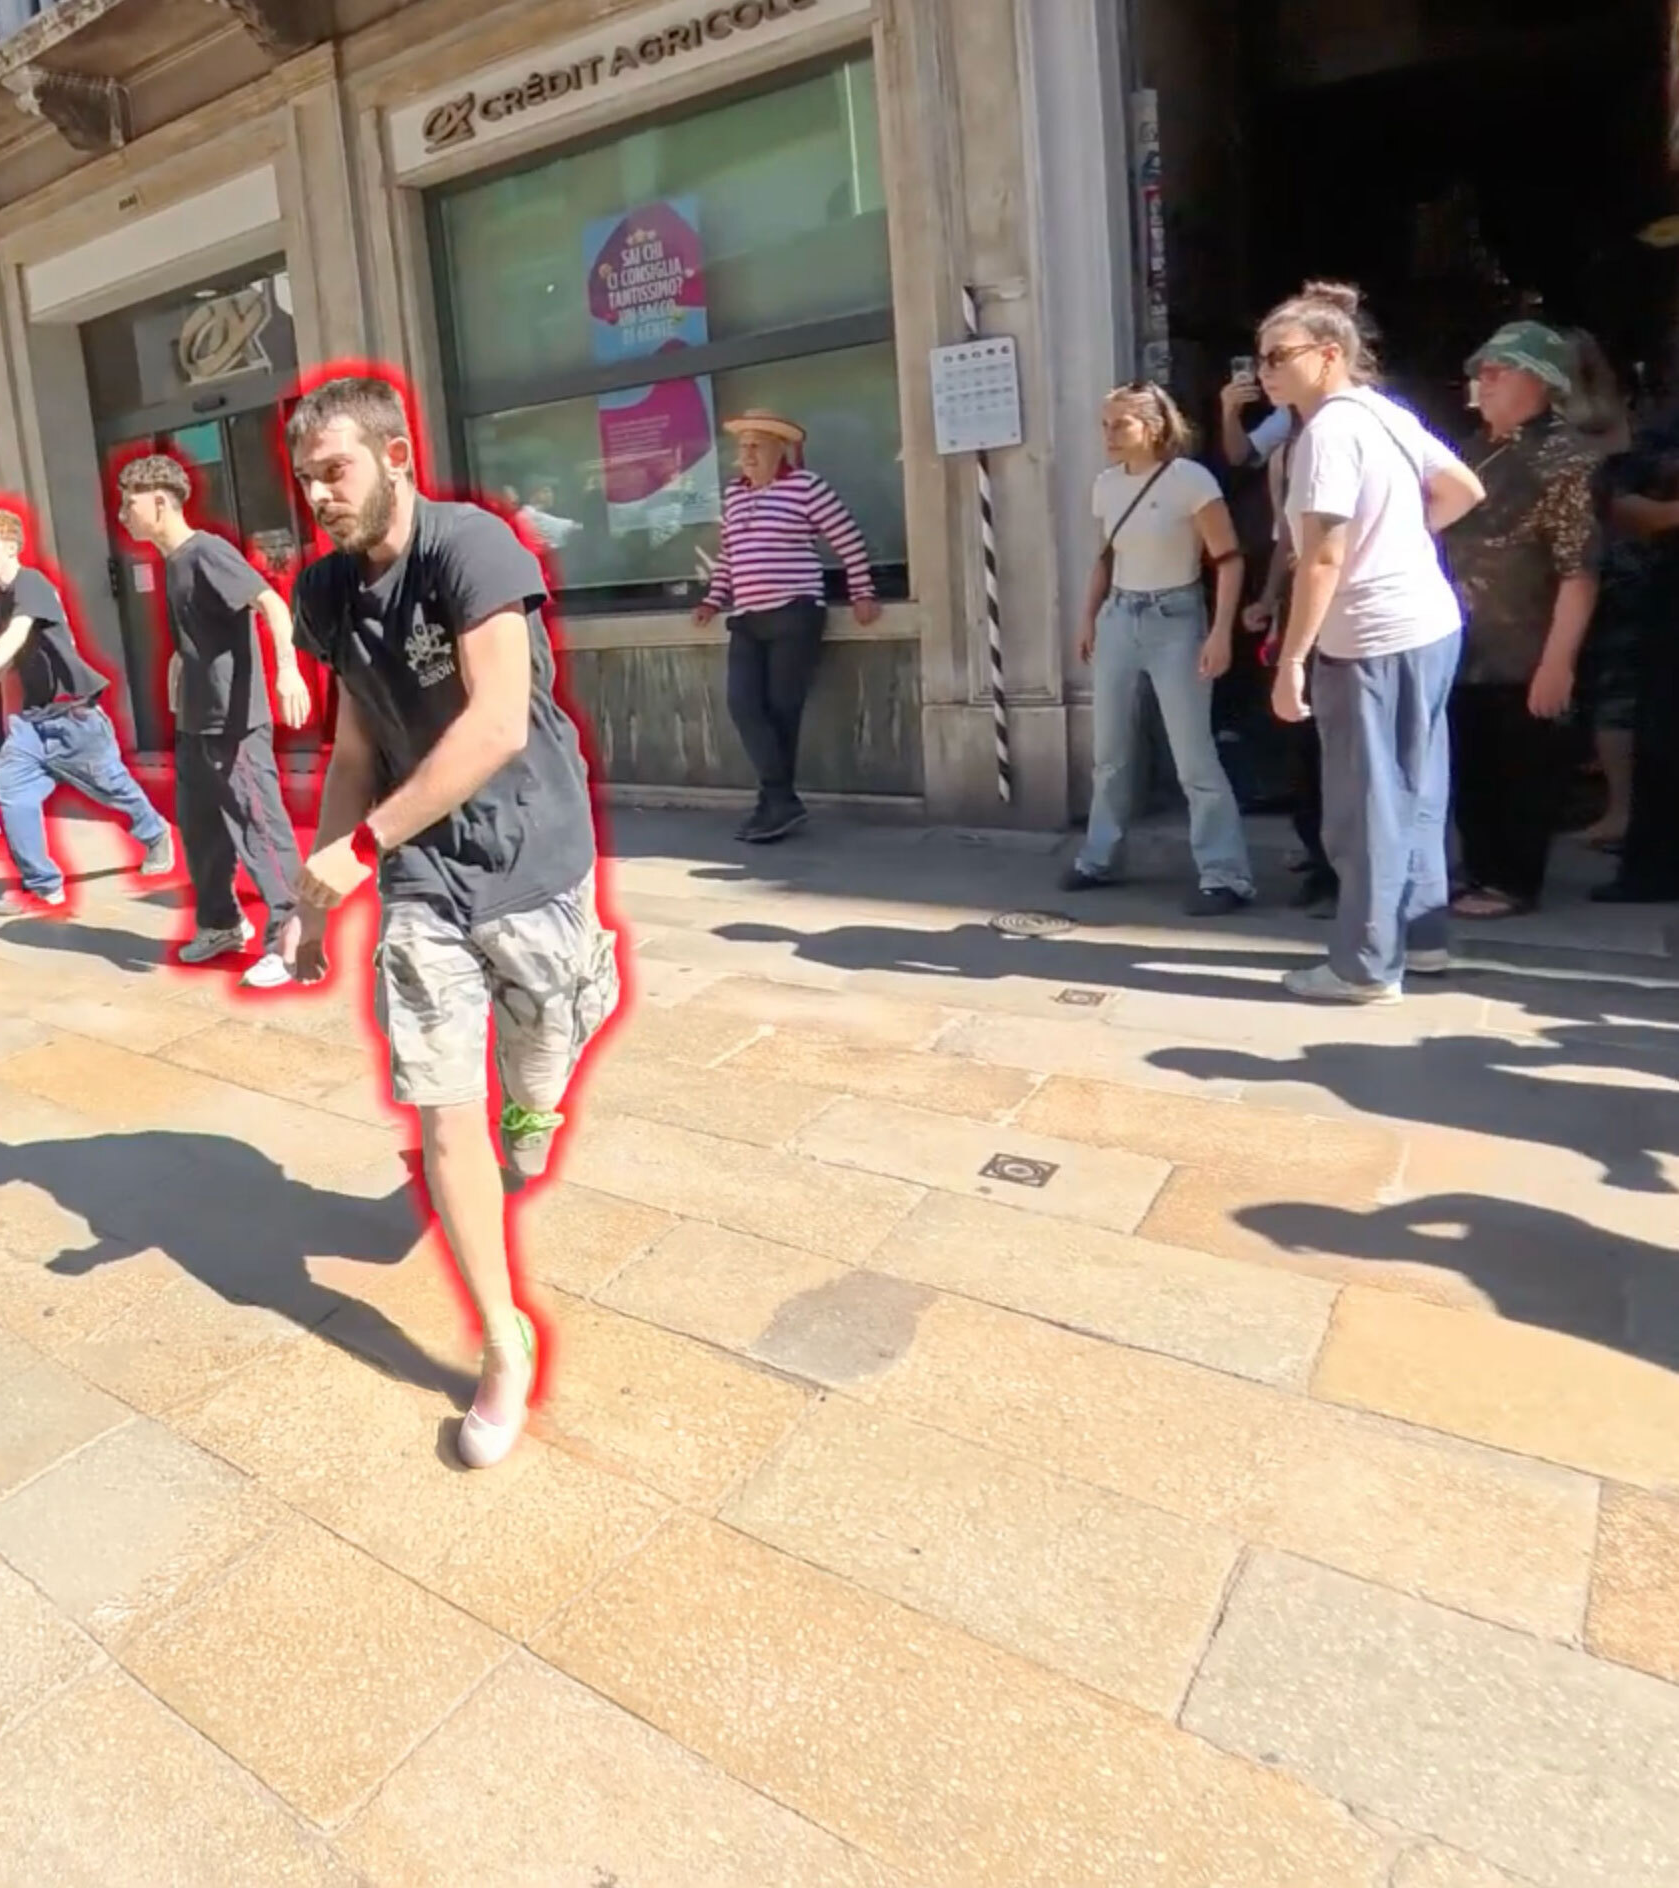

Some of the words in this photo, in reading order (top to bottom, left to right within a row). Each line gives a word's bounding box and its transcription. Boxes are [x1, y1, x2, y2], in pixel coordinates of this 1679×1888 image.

[480, 56, 604, 121] CRÉDIT
[621, 246, 641, 267] SAI
[642, 240, 664, 261] CHI
[620, 256, 682, 287] CONSIGLIA
[608, 275, 684, 307] TANTISSIMO?
